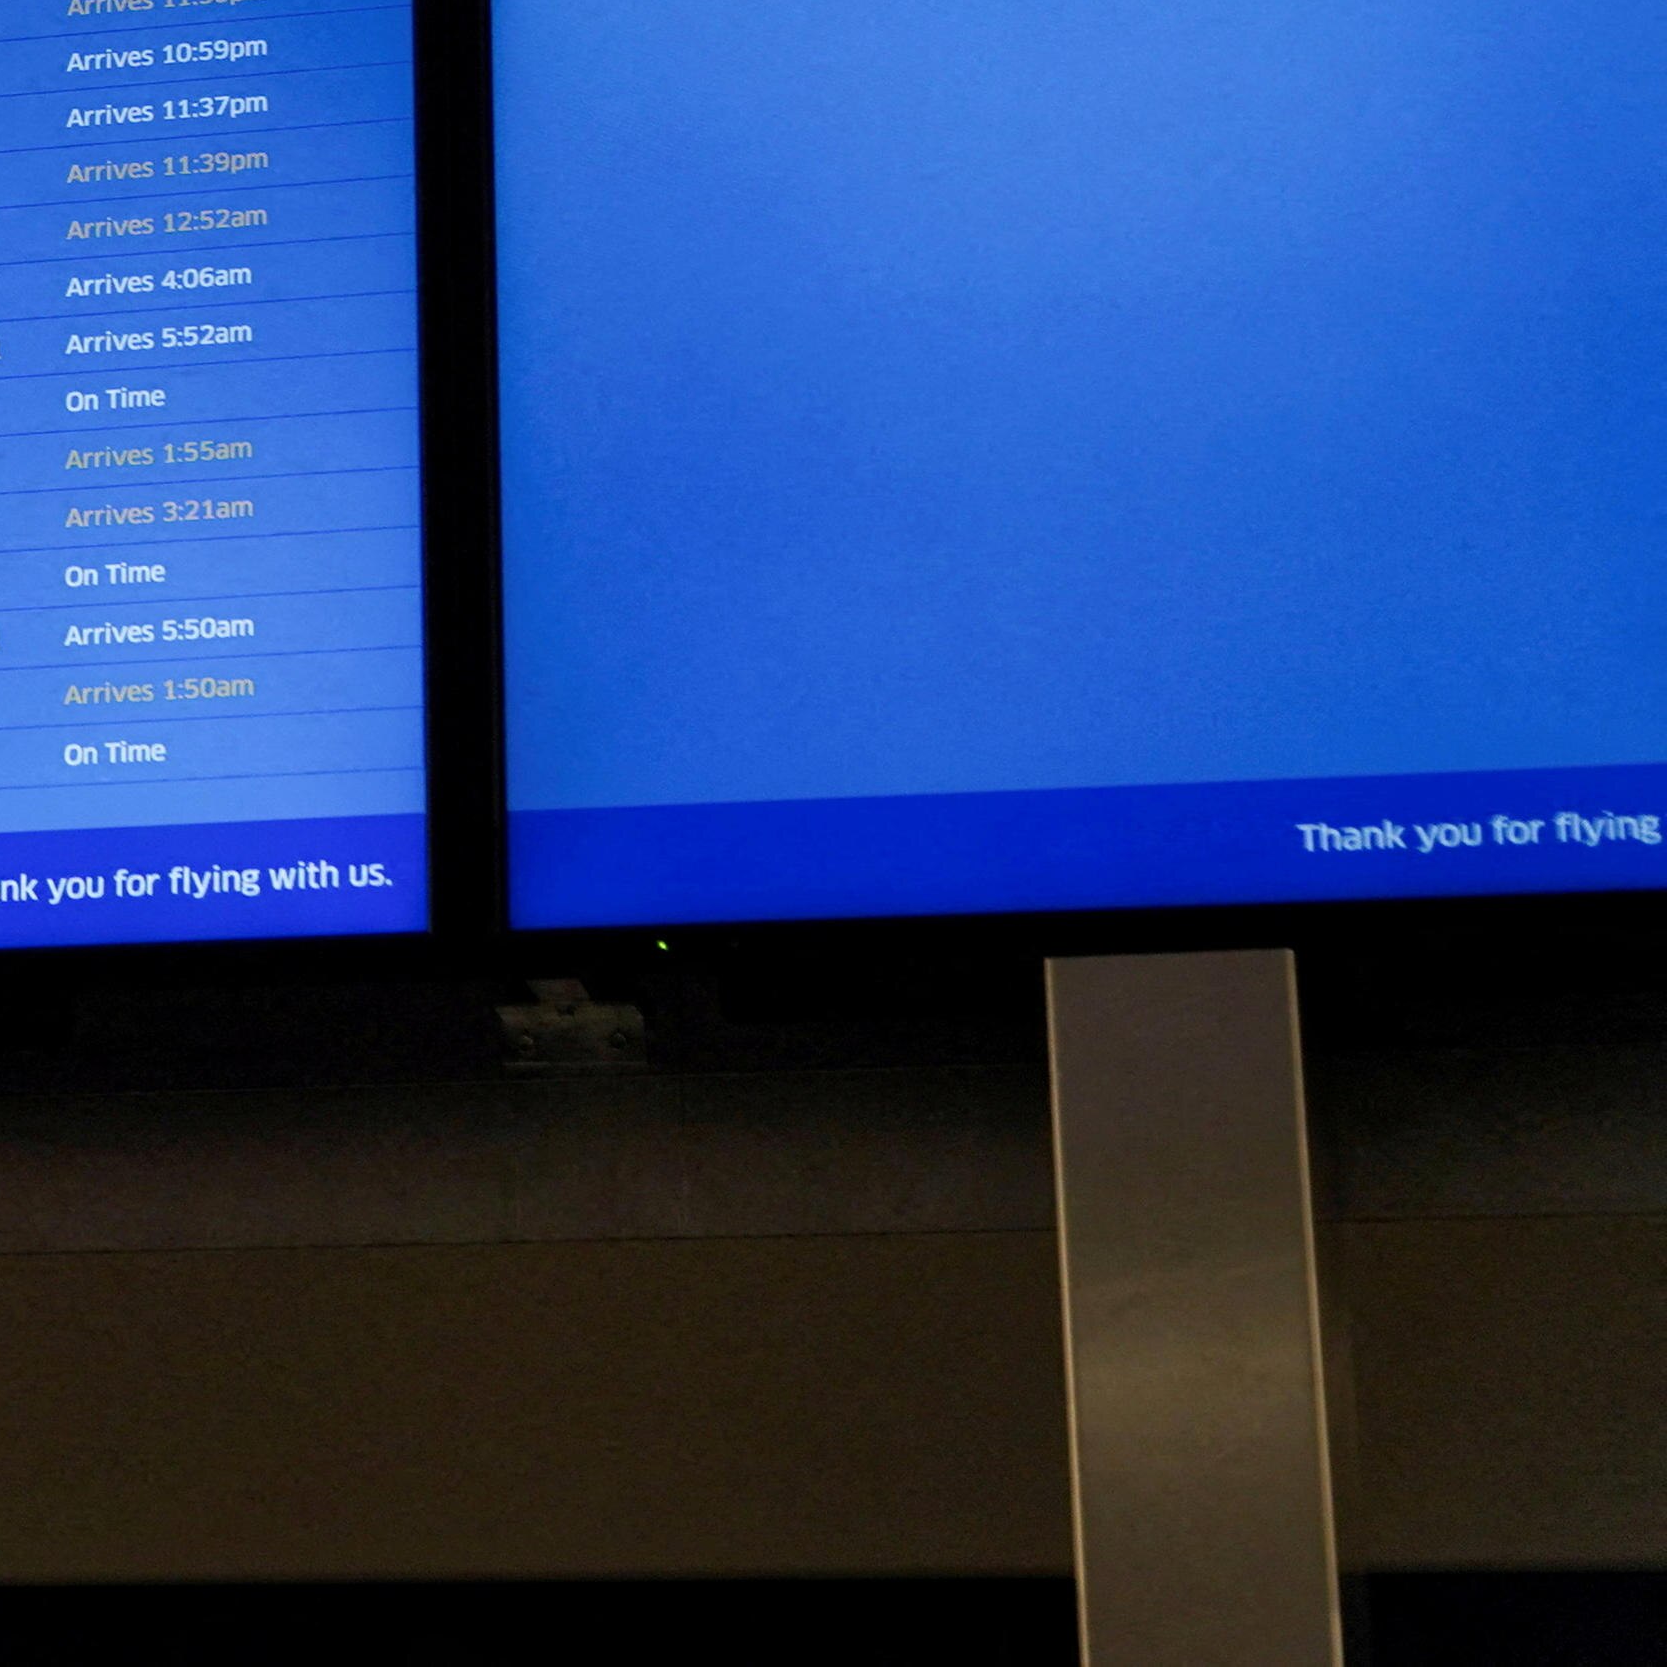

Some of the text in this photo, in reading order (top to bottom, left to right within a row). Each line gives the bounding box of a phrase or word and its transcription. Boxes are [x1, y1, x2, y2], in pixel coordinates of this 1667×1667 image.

[63, 739, 167, 767] On Time
[1295, 810, 1663, 853] Thank you for flying
[46, 875, 105, 906] you
[112, 868, 161, 898] for
[168, 864, 261, 899] flying
[268, 859, 340, 891] with
[348, 863, 393, 888] us.
